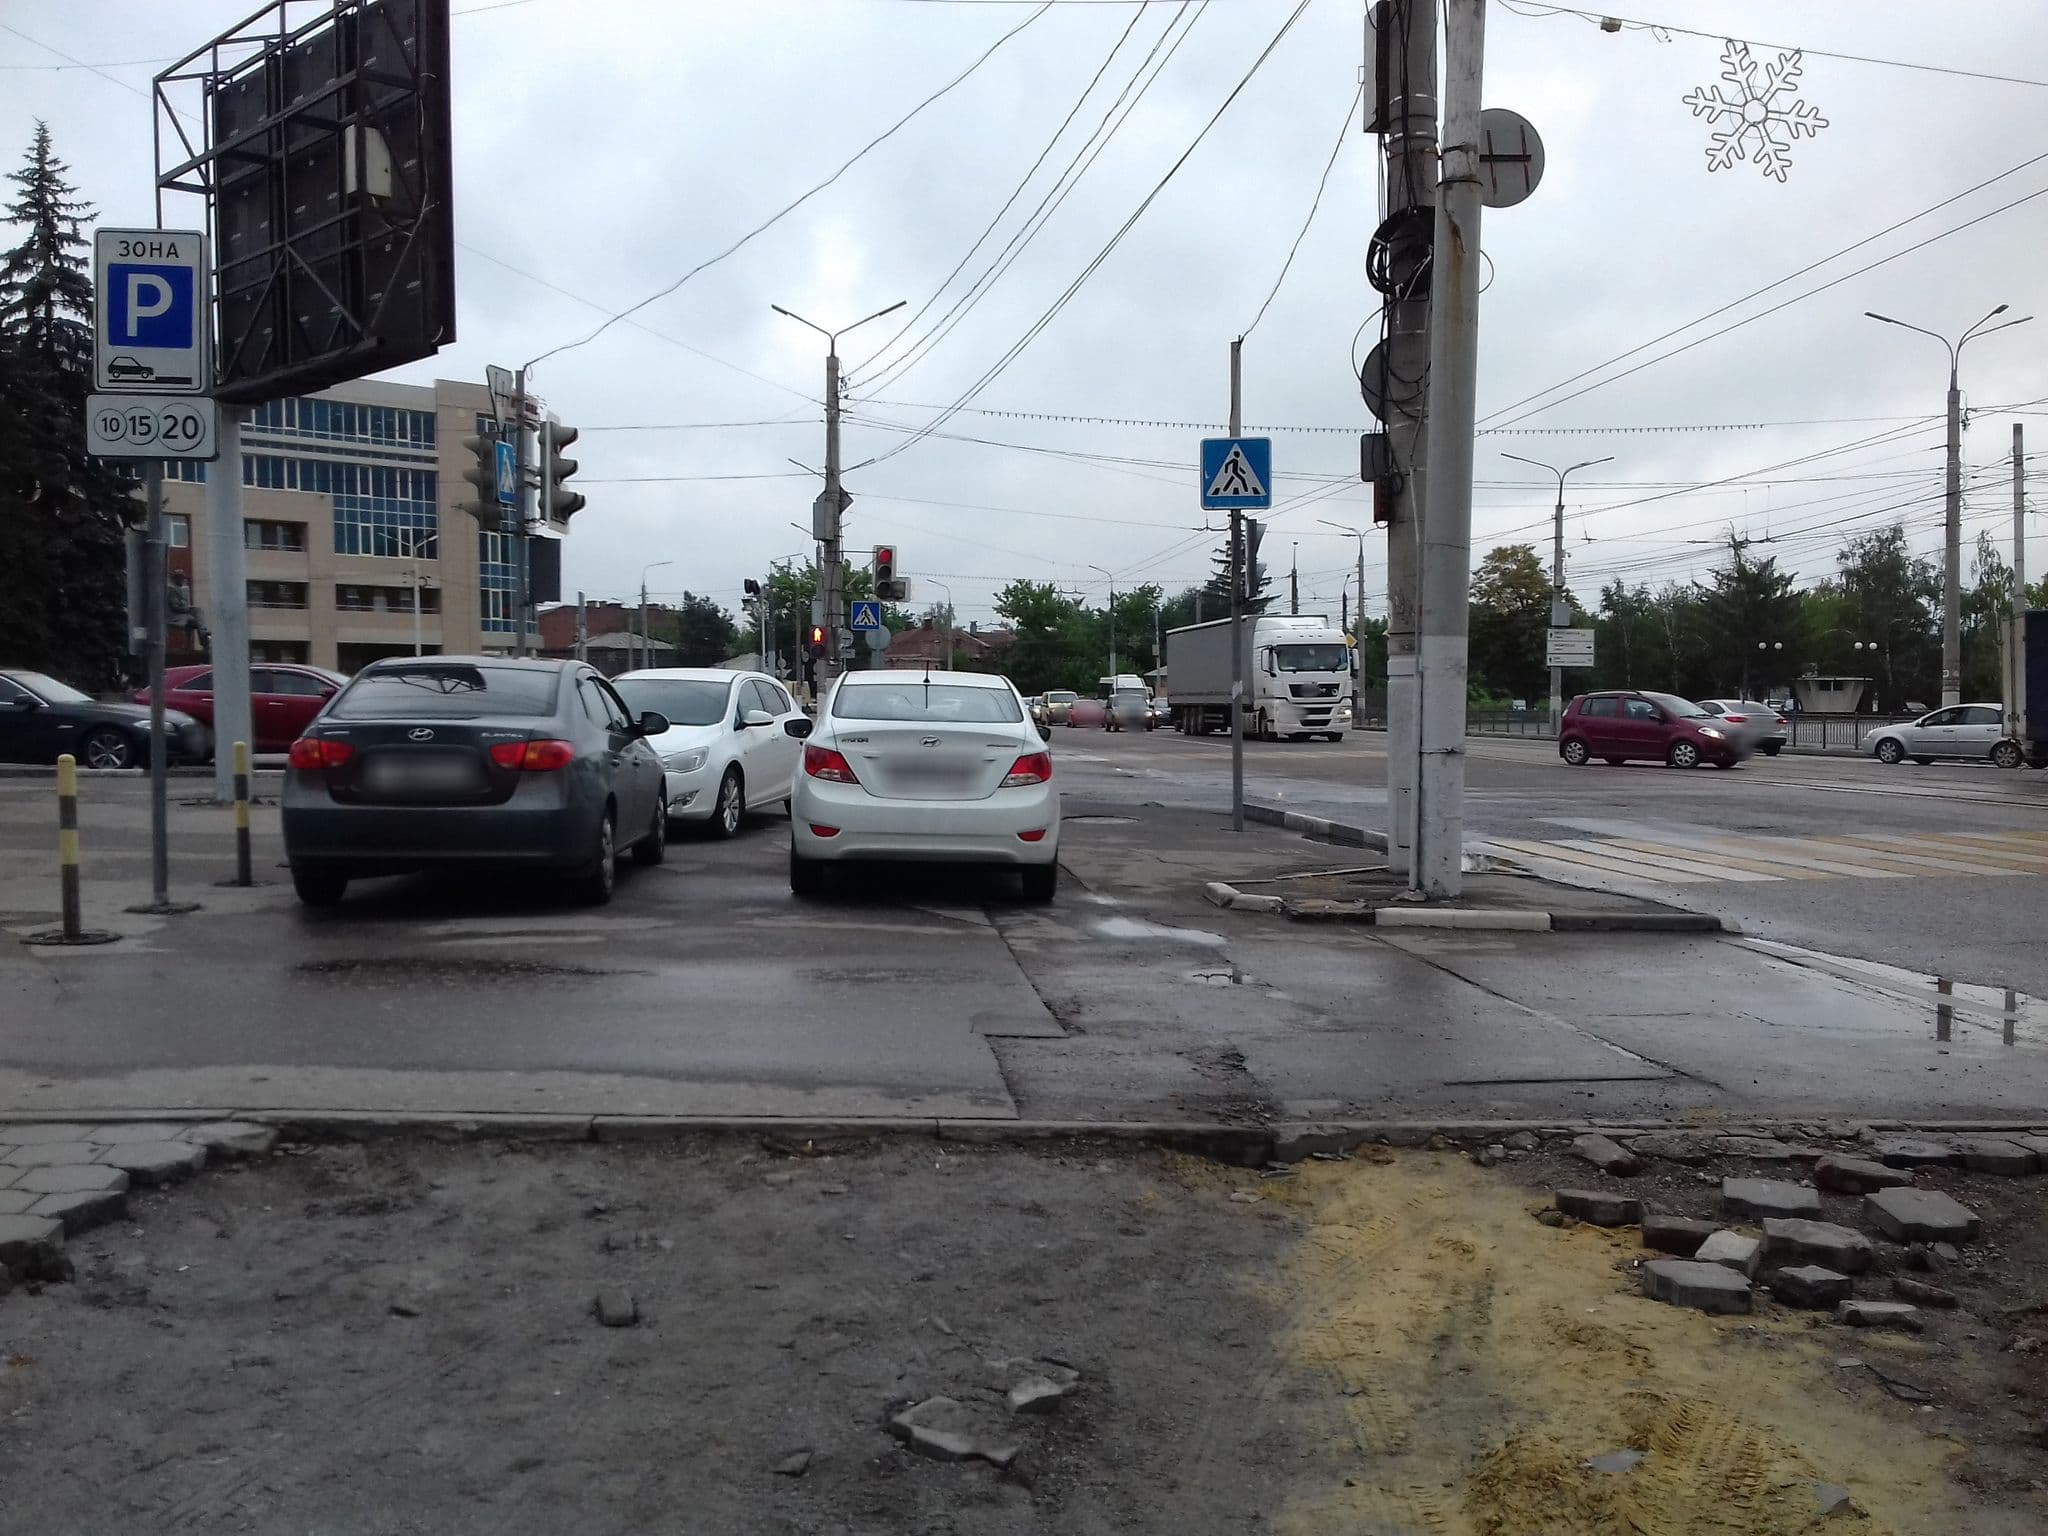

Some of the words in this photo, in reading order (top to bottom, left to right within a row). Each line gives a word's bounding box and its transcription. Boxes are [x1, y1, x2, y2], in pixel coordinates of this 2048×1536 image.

[118, 240, 179, 259] ЗОНА
[127, 273, 173, 337] P
[101, 416, 120, 433] 10
[129, 415, 151, 437] 15
[162, 414, 199, 440] 20
